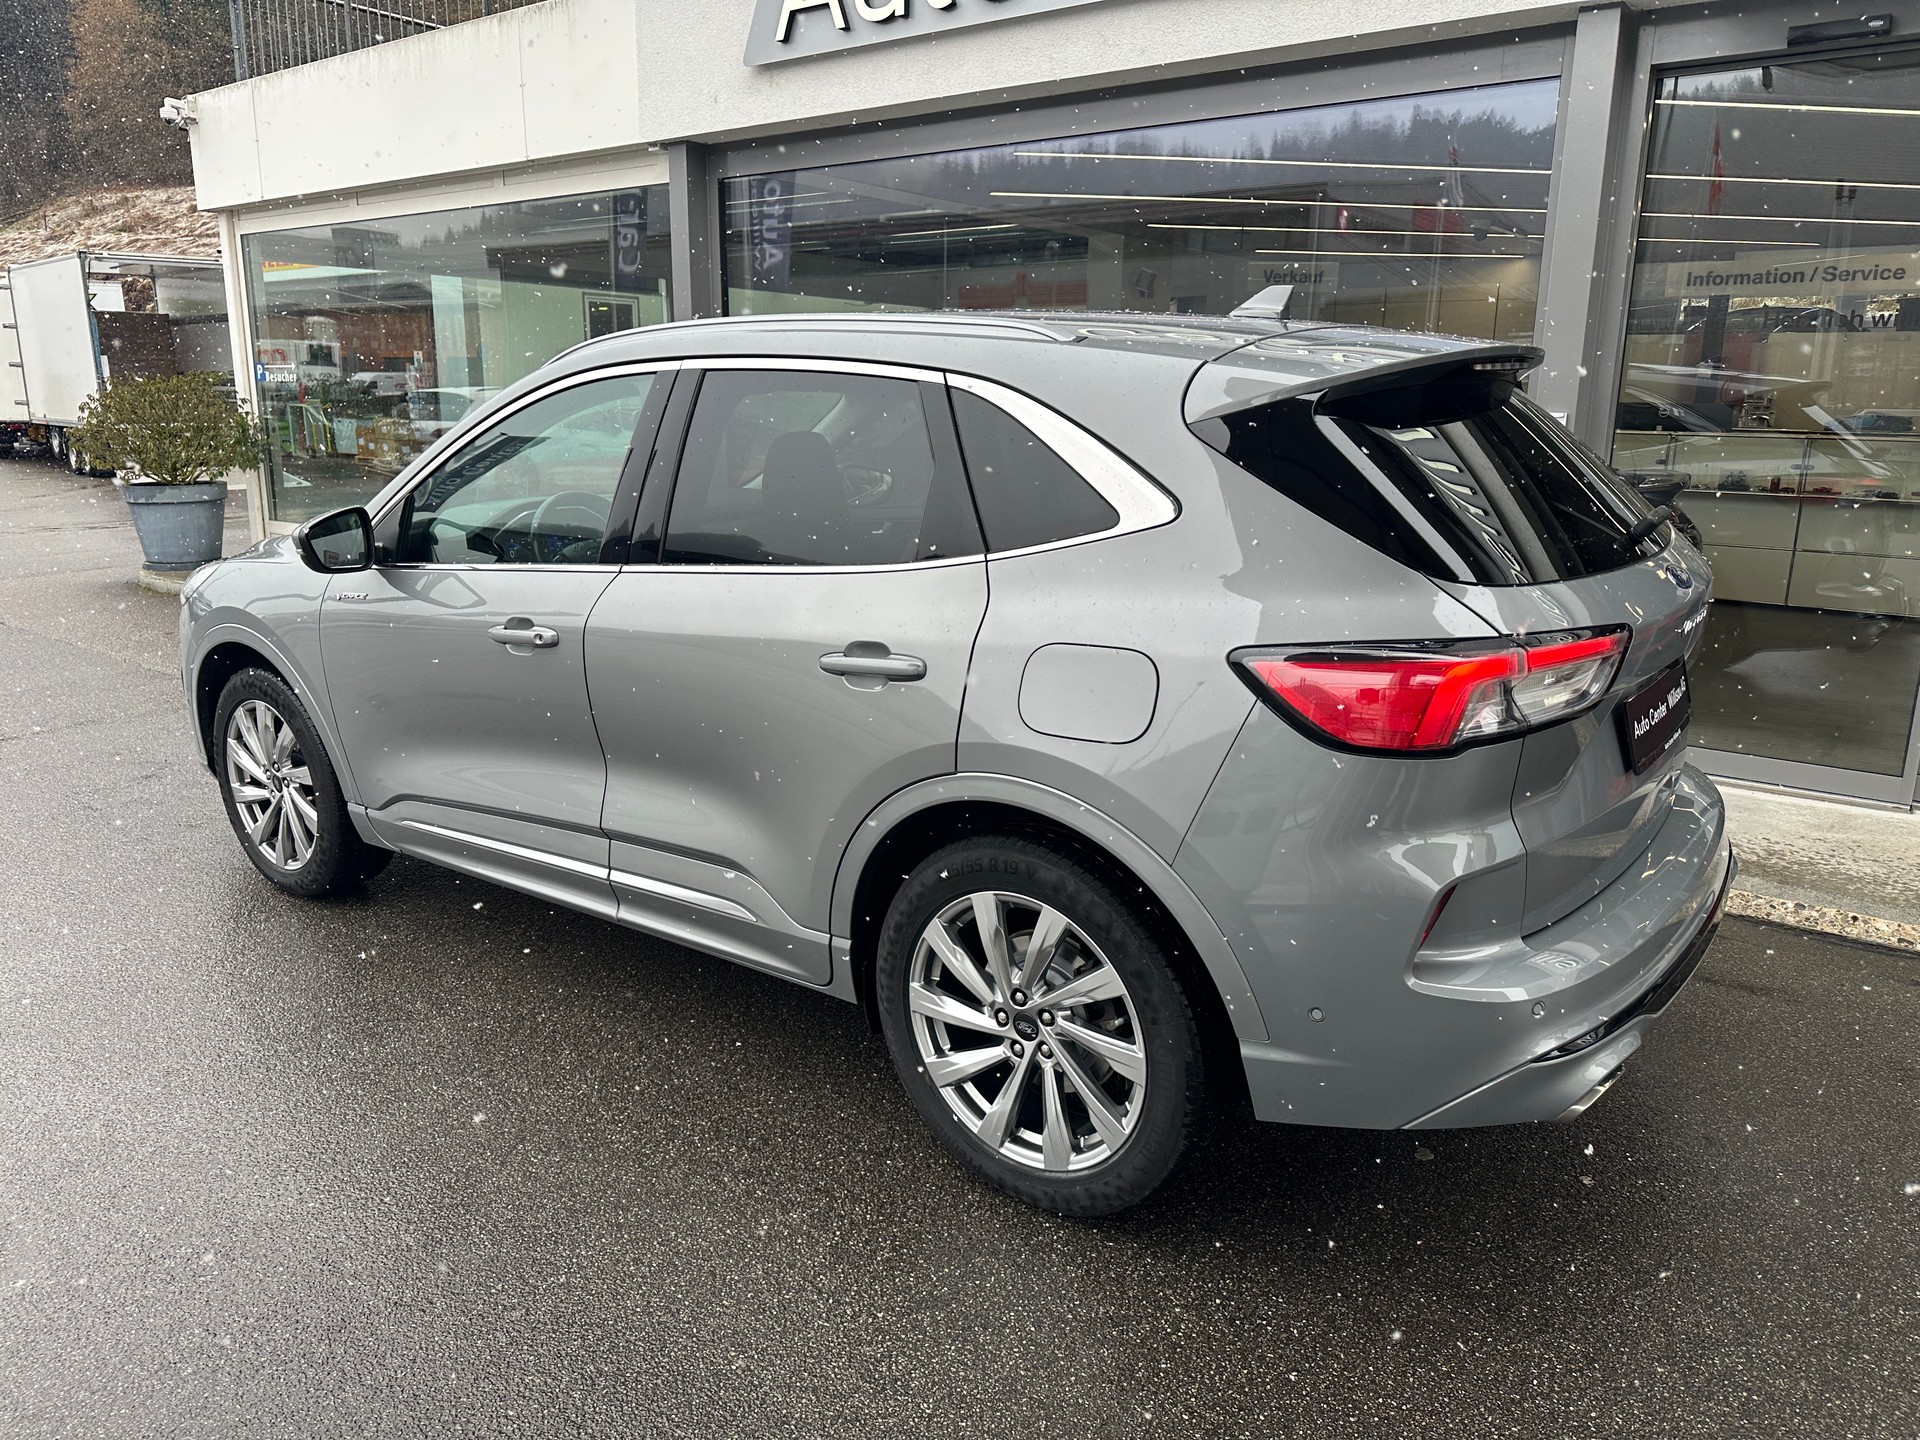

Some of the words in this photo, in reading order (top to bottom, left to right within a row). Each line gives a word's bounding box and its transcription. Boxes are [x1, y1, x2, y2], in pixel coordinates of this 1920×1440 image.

[1263, 269, 1325, 284] Verkauf
[1686, 268, 1805, 287] Information
[1809, 267, 1819, 283] /
[1821, 264, 1907, 282] Service
[256, 364, 263, 380] P
[264, 370, 297, 383] Besucher
[1634, 715, 1650, 740] Auto
[1649, 701, 1668, 726] Center
[988, 857, 999, 873] R
[1003, 860, 1019, 875] 19
